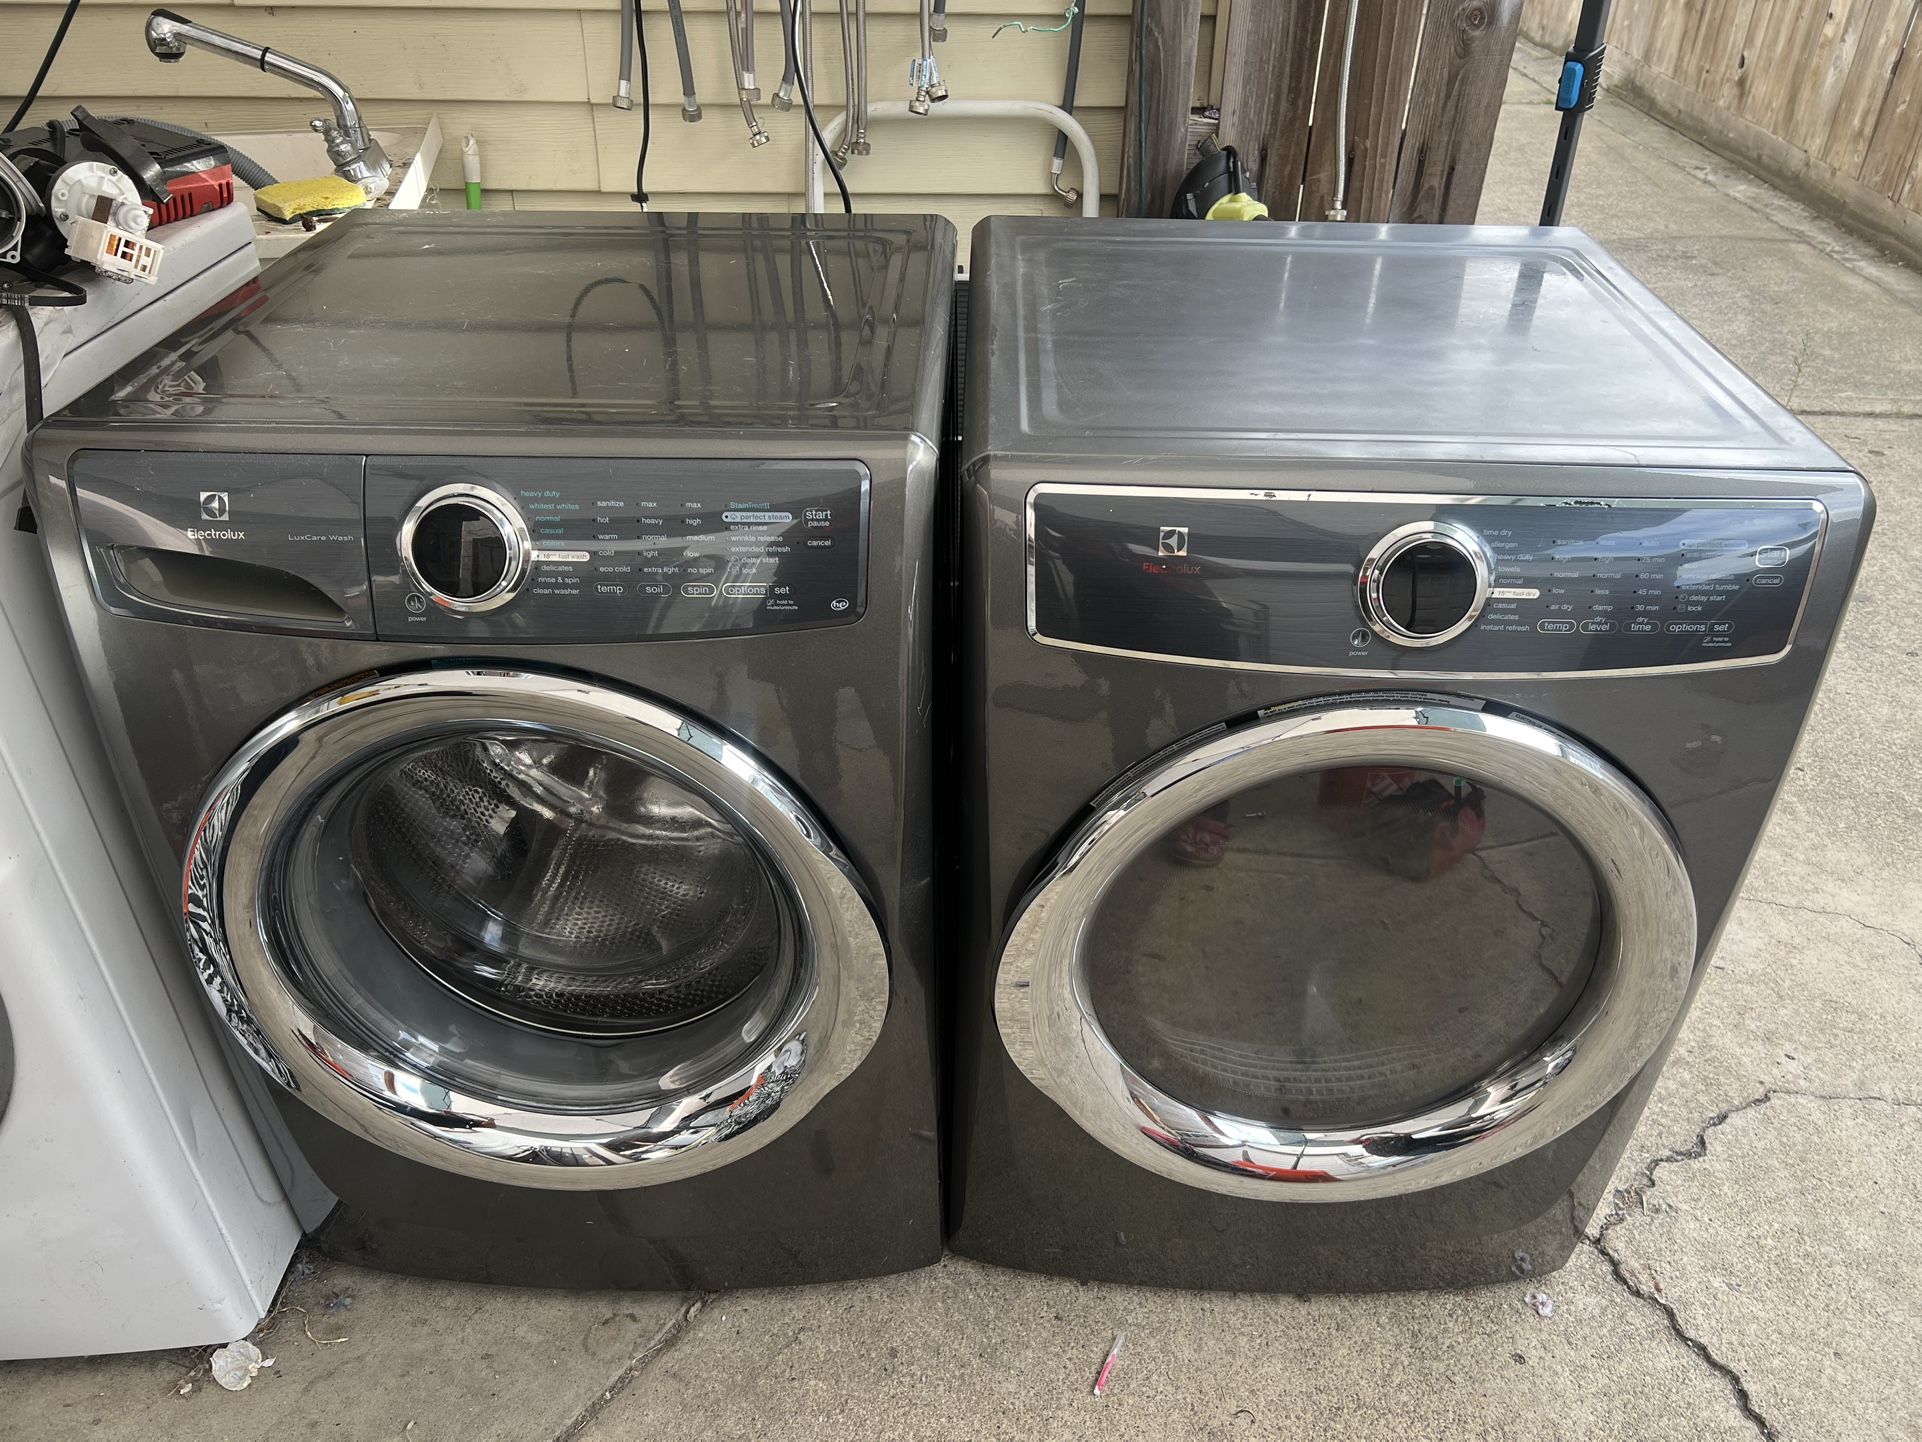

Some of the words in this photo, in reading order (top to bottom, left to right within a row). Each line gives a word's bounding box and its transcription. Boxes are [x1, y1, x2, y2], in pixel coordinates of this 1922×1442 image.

[521, 490, 542, 498] heavy
[544, 490, 560, 498] duty
[740, 513, 767, 521] perfect
[805, 509, 832, 519] start
[641, 517, 663, 526] heavy
[686, 518, 702, 526] high
[808, 520, 830, 528] pause
[187, 528, 245, 540] Electrolux
[1500, 529, 1512, 537] dry
[643, 550, 659, 558] light
[615, 565, 631, 573] cold
[663, 566, 679, 574] light
[564, 577, 580, 585] spin
[597, 585, 624, 595] temp
[645, 585, 663, 594] soil
[687, 586, 709, 595] spin
[728, 586, 766, 596] options
[774, 586, 790, 594] set
[1526, 590, 1537, 598] dry
[1592, 604, 1613, 612] damp
[1544, 622, 1570, 631] temp
[1588, 622, 1610, 631] level
[1631, 623, 1652, 631] time
[1669, 623, 1706, 633] options
[1713, 623, 1729, 631] set
